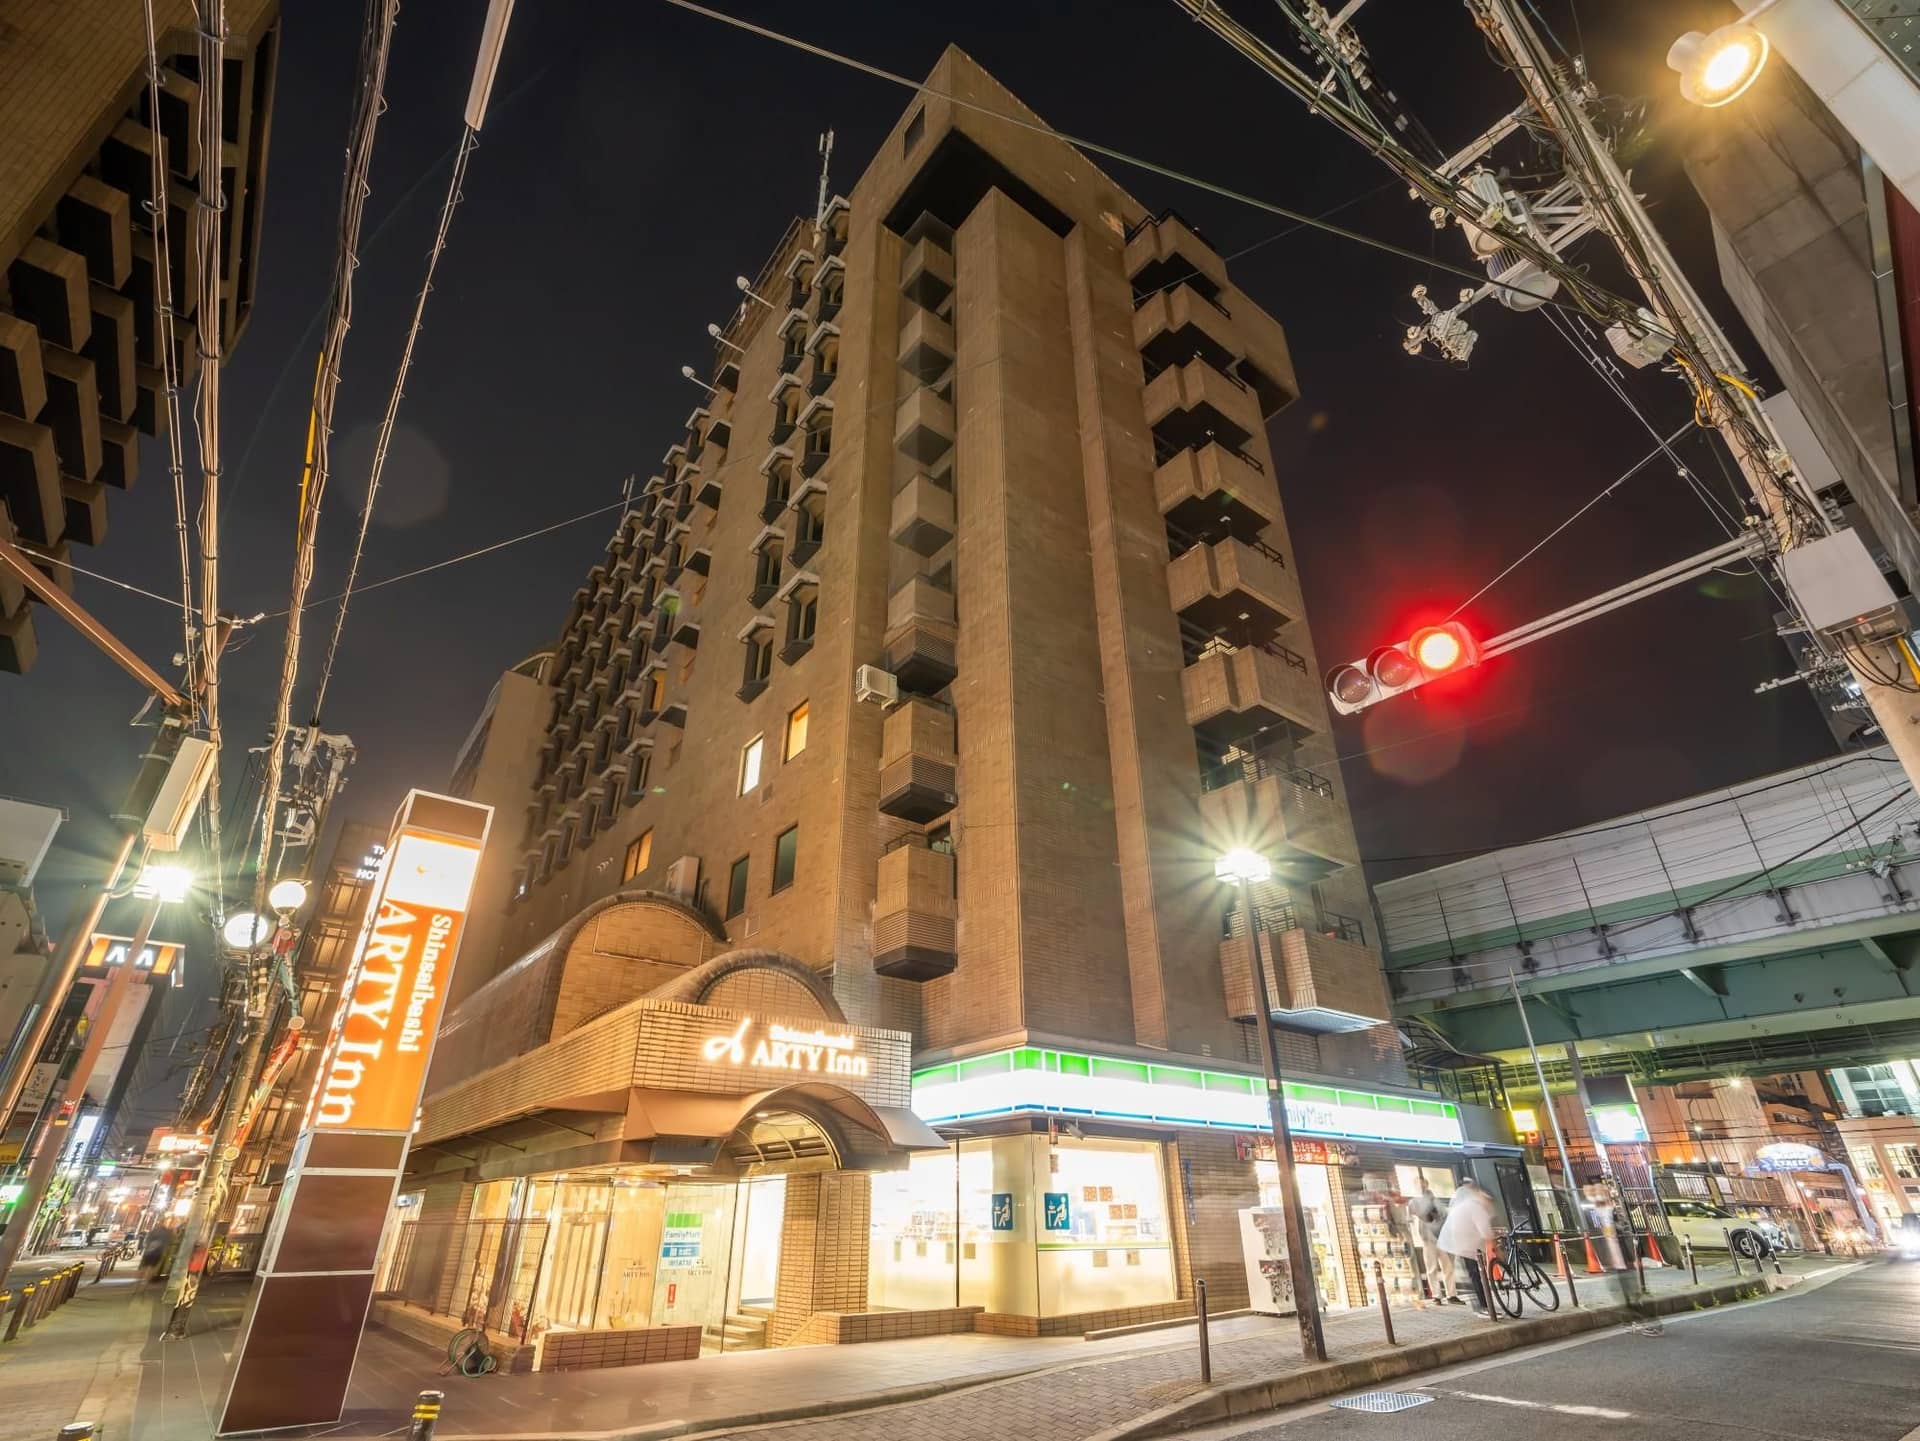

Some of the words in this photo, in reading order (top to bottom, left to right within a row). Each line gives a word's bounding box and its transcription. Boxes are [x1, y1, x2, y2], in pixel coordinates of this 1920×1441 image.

[347, 898, 417, 1030] ARTY
[397, 913, 452, 1053] Shinsaibashi
[318, 1039, 383, 1126] Inn
[751, 1040, 823, 1071] ARTY
[826, 1049, 869, 1076] Inn
